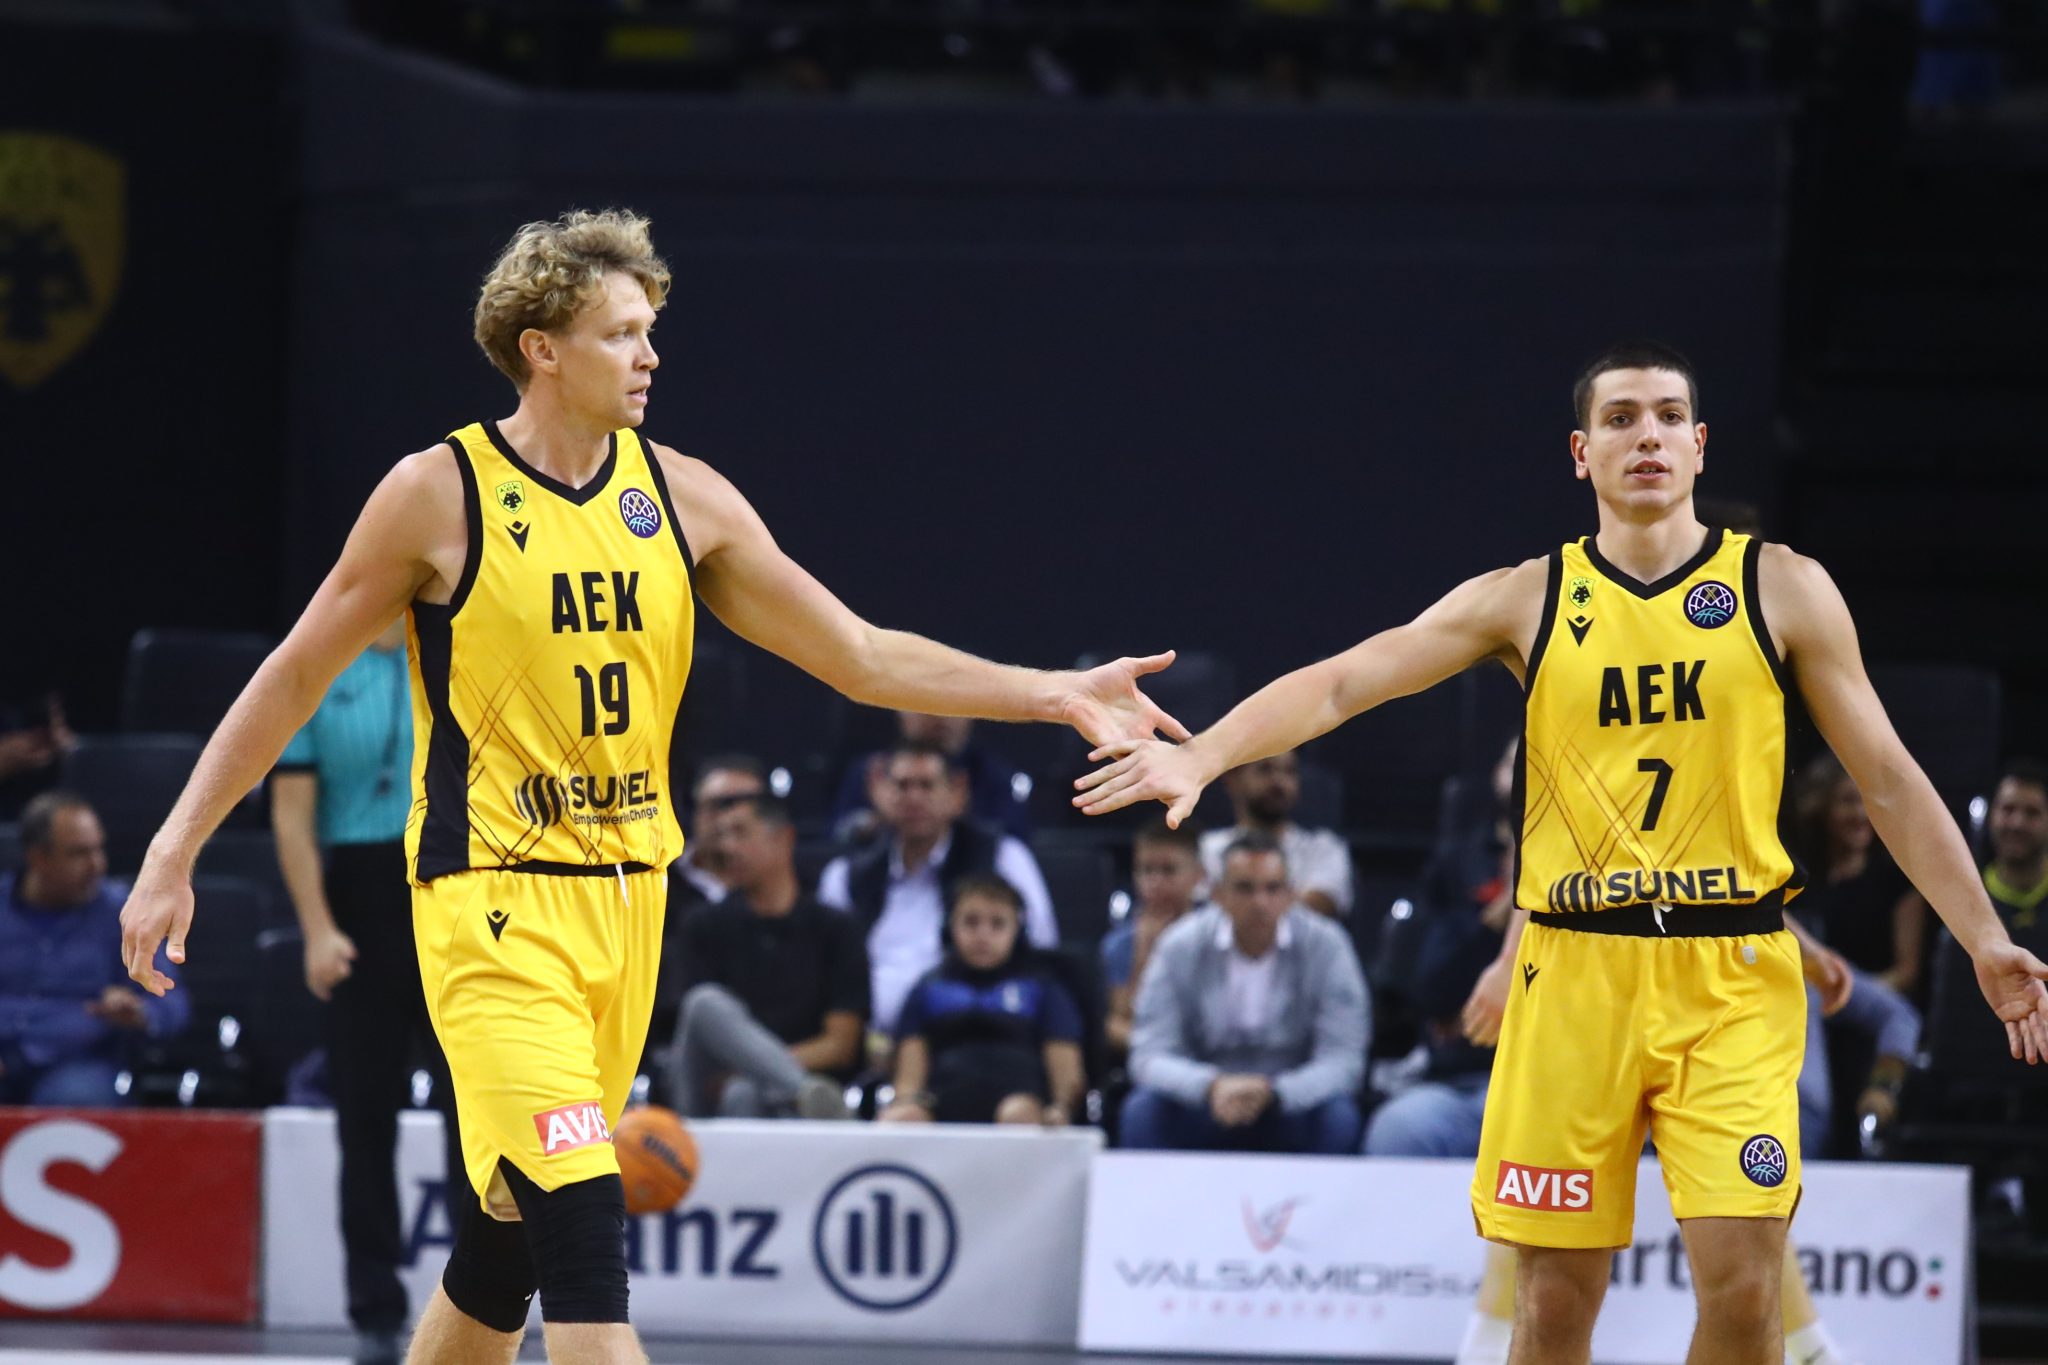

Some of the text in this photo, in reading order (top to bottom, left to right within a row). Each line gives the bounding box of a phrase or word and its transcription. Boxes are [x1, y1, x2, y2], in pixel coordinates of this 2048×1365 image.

[552, 571, 644, 634] AEK
[573, 661, 631, 737] 19
[1599, 659, 1706, 727] AEK
[570, 769, 658, 810] SUNEL
[1637, 758, 1674, 831] 7
[1605, 867, 1756, 903] SUNEL
[1497, 1167, 1590, 1207] AVIS
